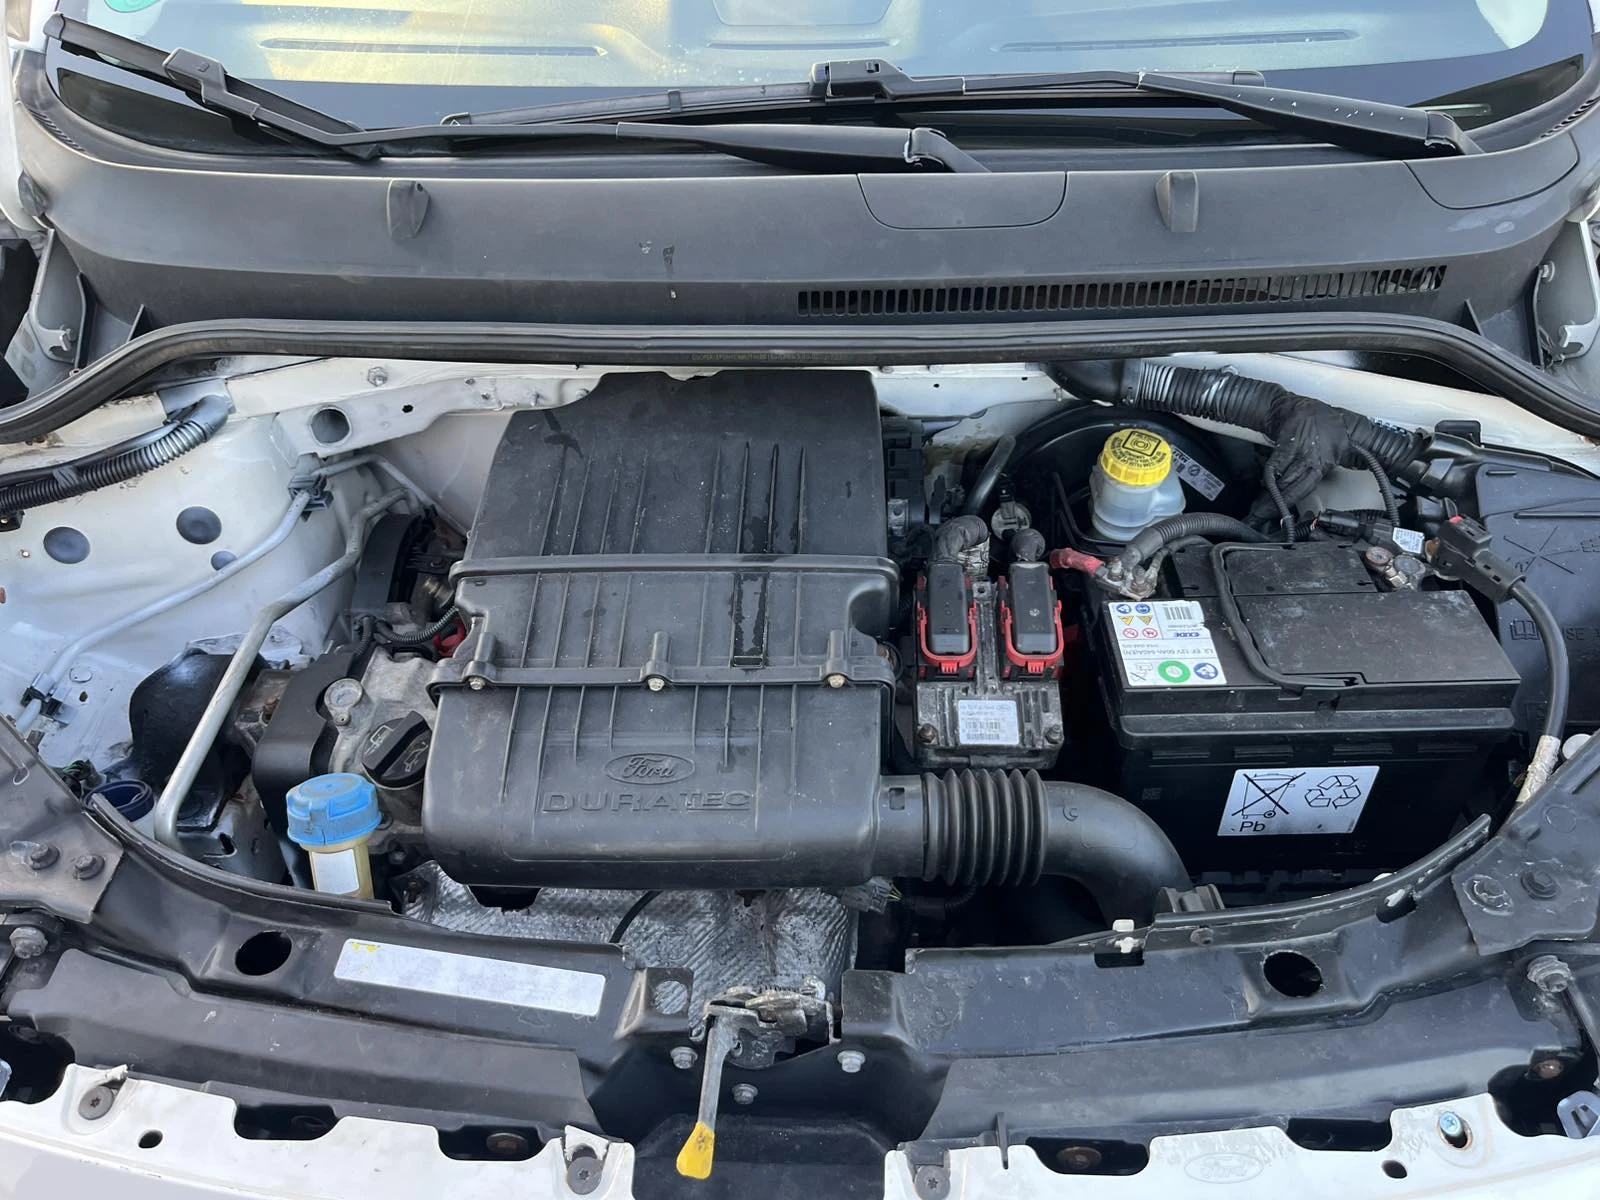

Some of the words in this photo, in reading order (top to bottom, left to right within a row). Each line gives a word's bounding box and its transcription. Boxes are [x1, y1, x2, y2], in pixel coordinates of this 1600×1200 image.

[623, 756, 677, 779] Ford
[541, 790, 752, 813] DURATEC
[1239, 820, 1266, 832] Pb
